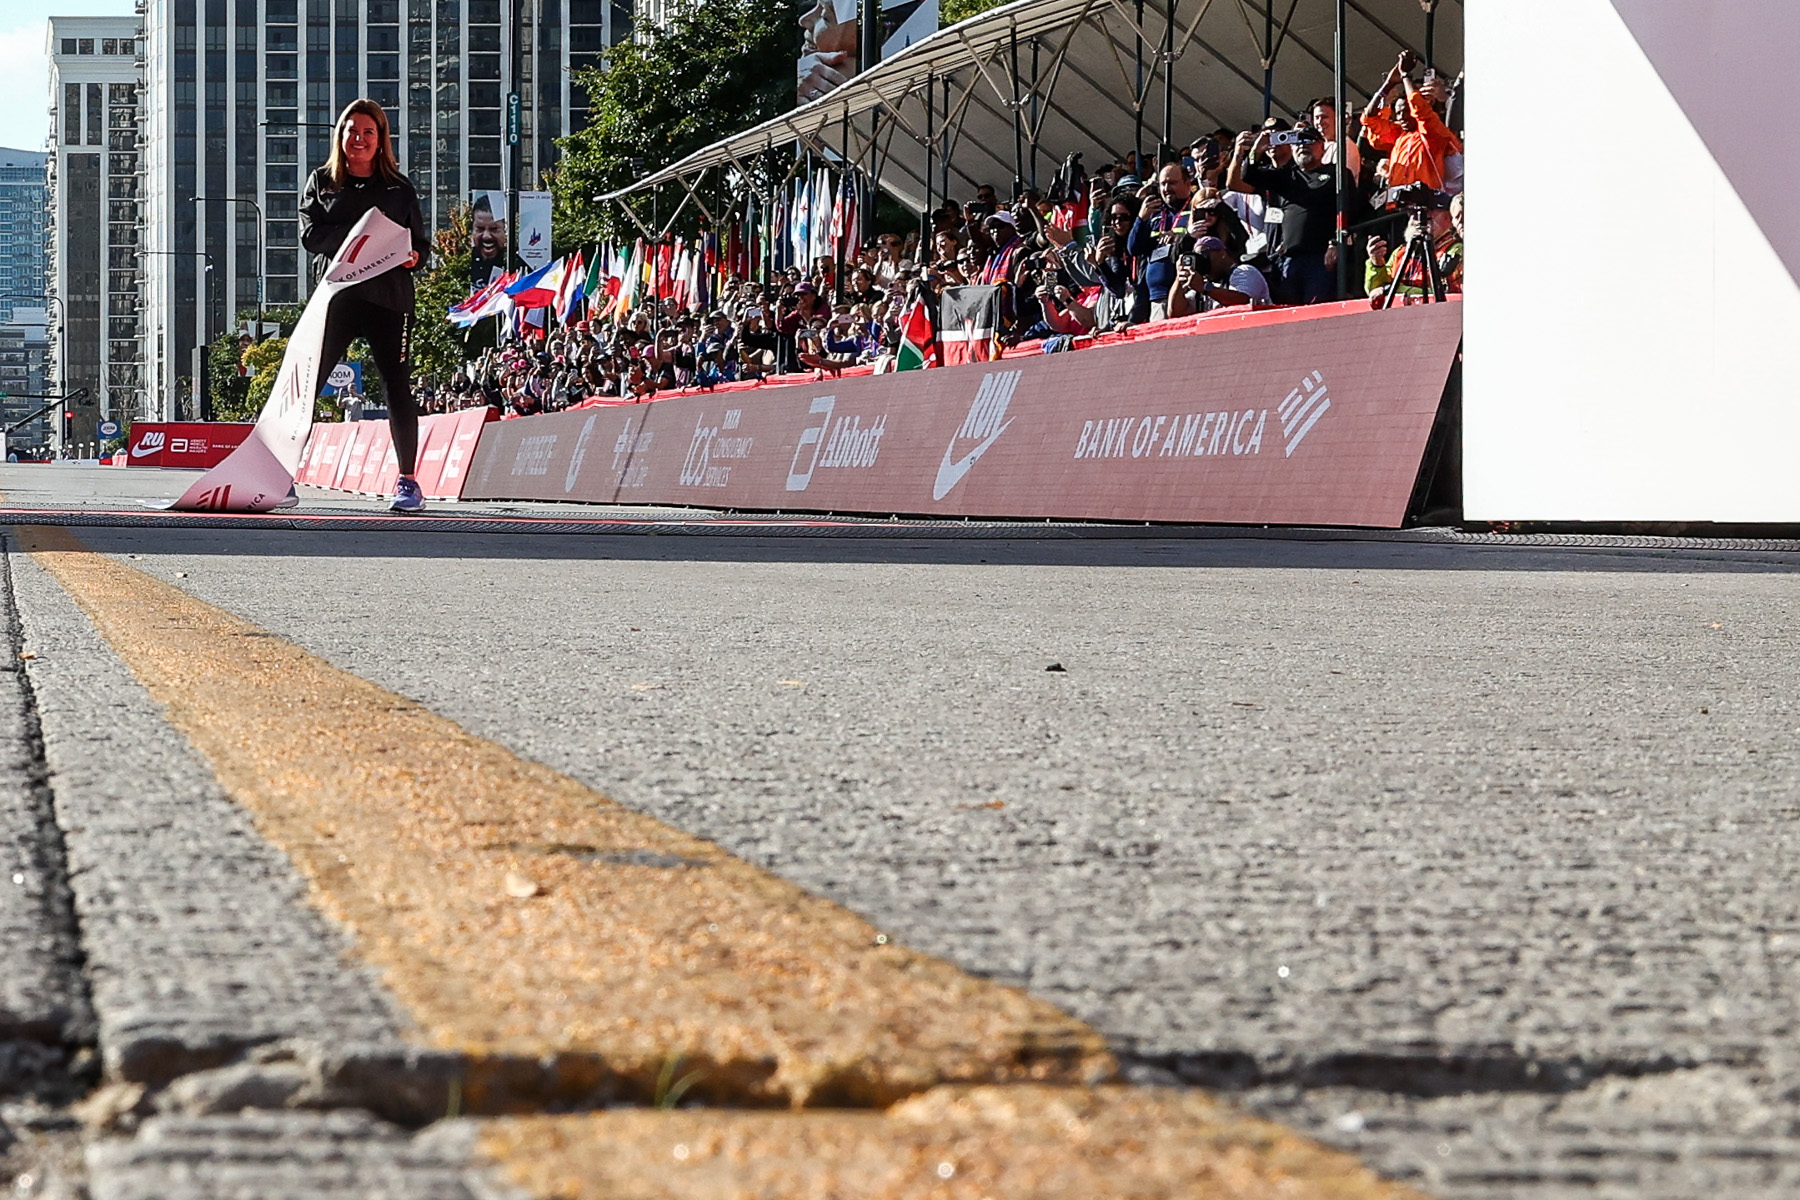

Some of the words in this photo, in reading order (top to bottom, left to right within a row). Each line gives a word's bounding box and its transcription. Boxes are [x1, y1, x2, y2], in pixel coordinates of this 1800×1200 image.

[509, 94, 519, 143] C1110
[346, 271, 357, 281] OF
[358, 252, 397, 274] AMERICA
[330, 371, 351, 379] 00M
[960, 369, 1023, 440] RUN
[819, 413, 888, 469] Abbott
[1074, 417, 1135, 460] BANK
[1131, 415, 1164, 459] OF
[1159, 409, 1269, 458] AMERICA
